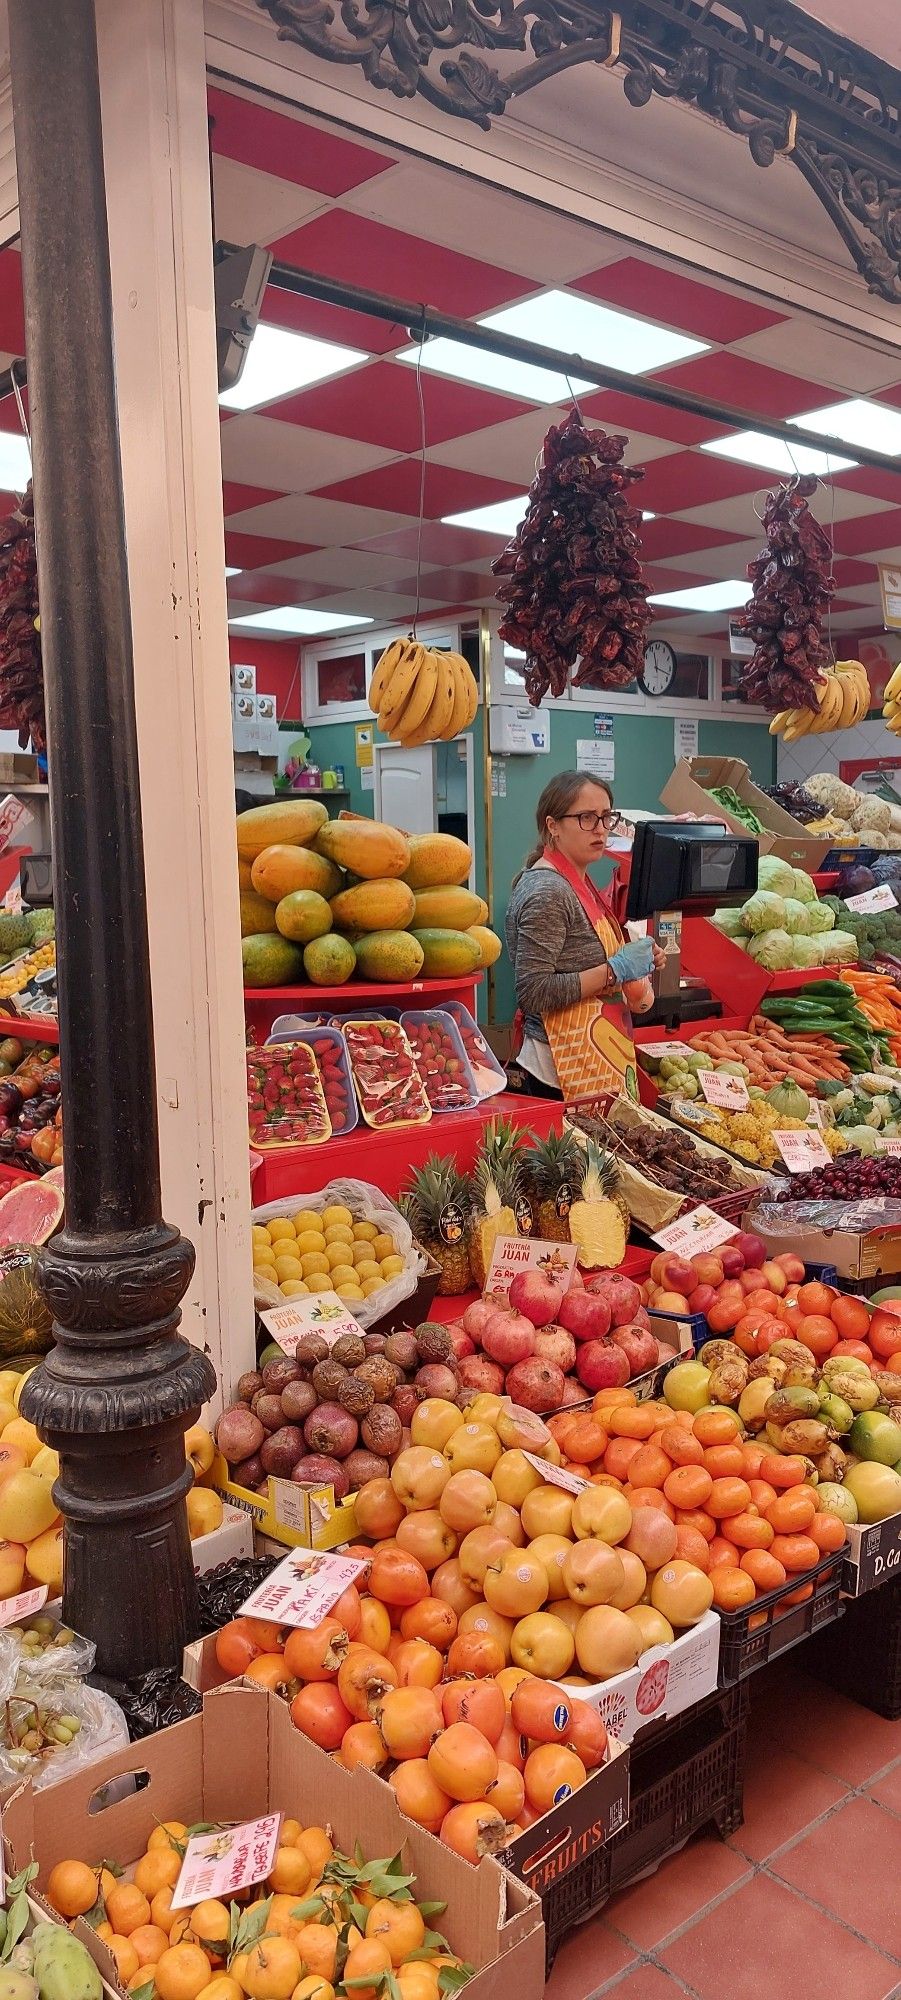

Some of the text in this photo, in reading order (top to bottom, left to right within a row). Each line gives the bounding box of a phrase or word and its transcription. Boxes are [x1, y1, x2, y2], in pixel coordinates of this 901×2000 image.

[666, 1229, 688, 1246] JUAN
[501, 1249, 530, 1262] JUAN
[275, 1314, 304, 1330] JUAN
[261, 1585, 293, 1612] JUAN
[525, 1820, 603, 1893] FRUITS
[194, 1867, 217, 1895] JUAN
